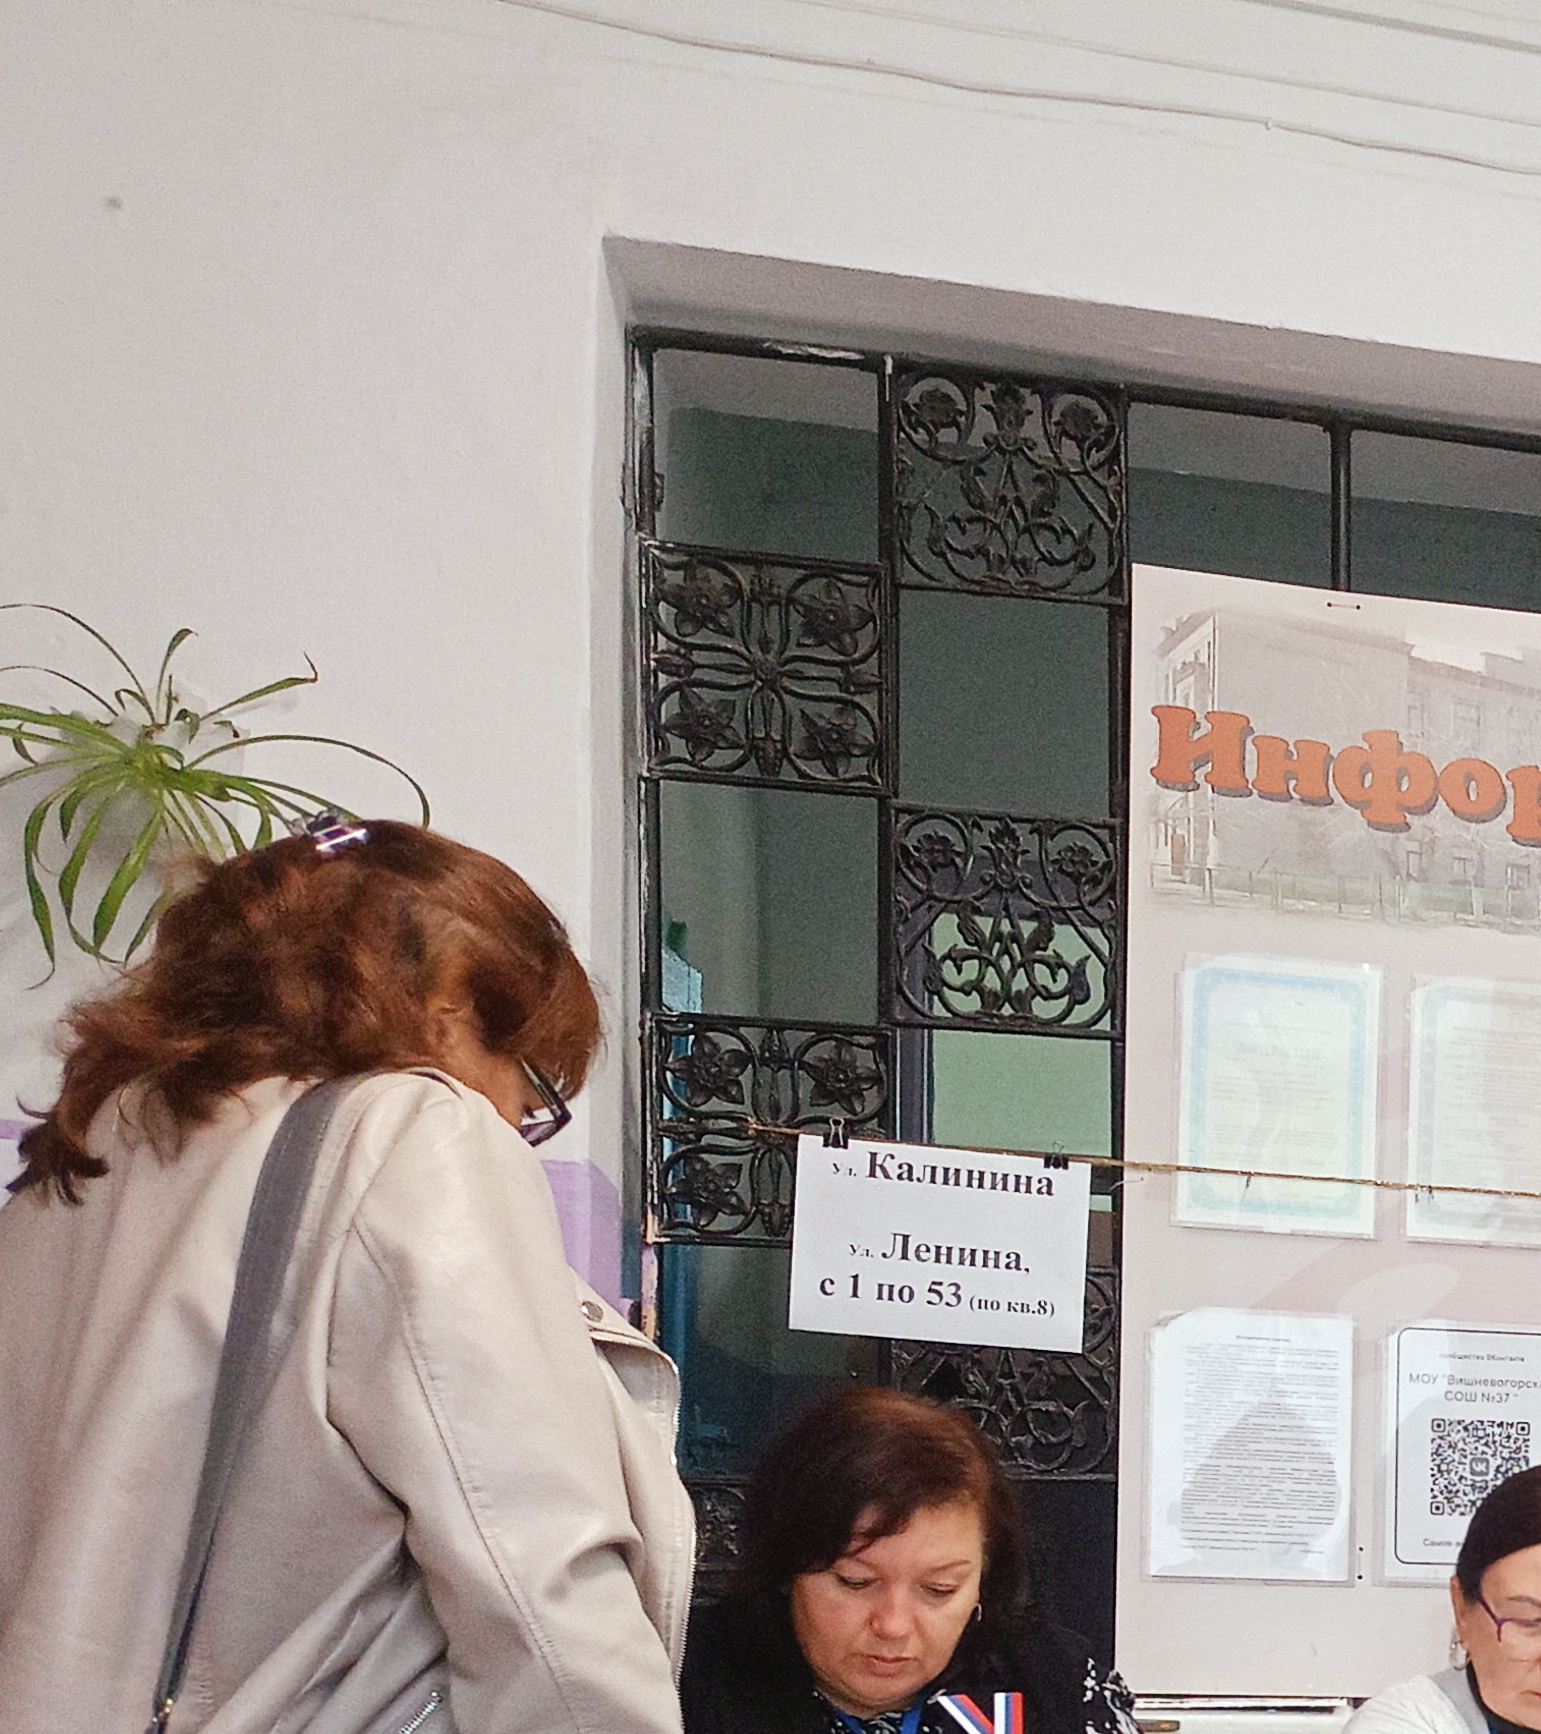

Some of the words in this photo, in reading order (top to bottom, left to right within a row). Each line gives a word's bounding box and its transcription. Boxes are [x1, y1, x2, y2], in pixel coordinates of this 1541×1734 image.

[866, 1150, 1055, 1197] Калинина
[881, 1232, 1030, 1274] Ленина,
[819, 1276, 836, 1297] с
[849, 1273, 861, 1299] 1
[875, 1281, 915, 1304] по
[926, 1280, 962, 1307] 53
[969, 1294, 1001, 1313] (по
[1006, 1299, 1056, 1318] кв.8)
[1408, 1372, 1439, 1385] МОУ
[1444, 1390, 1477, 1402] СОШ
